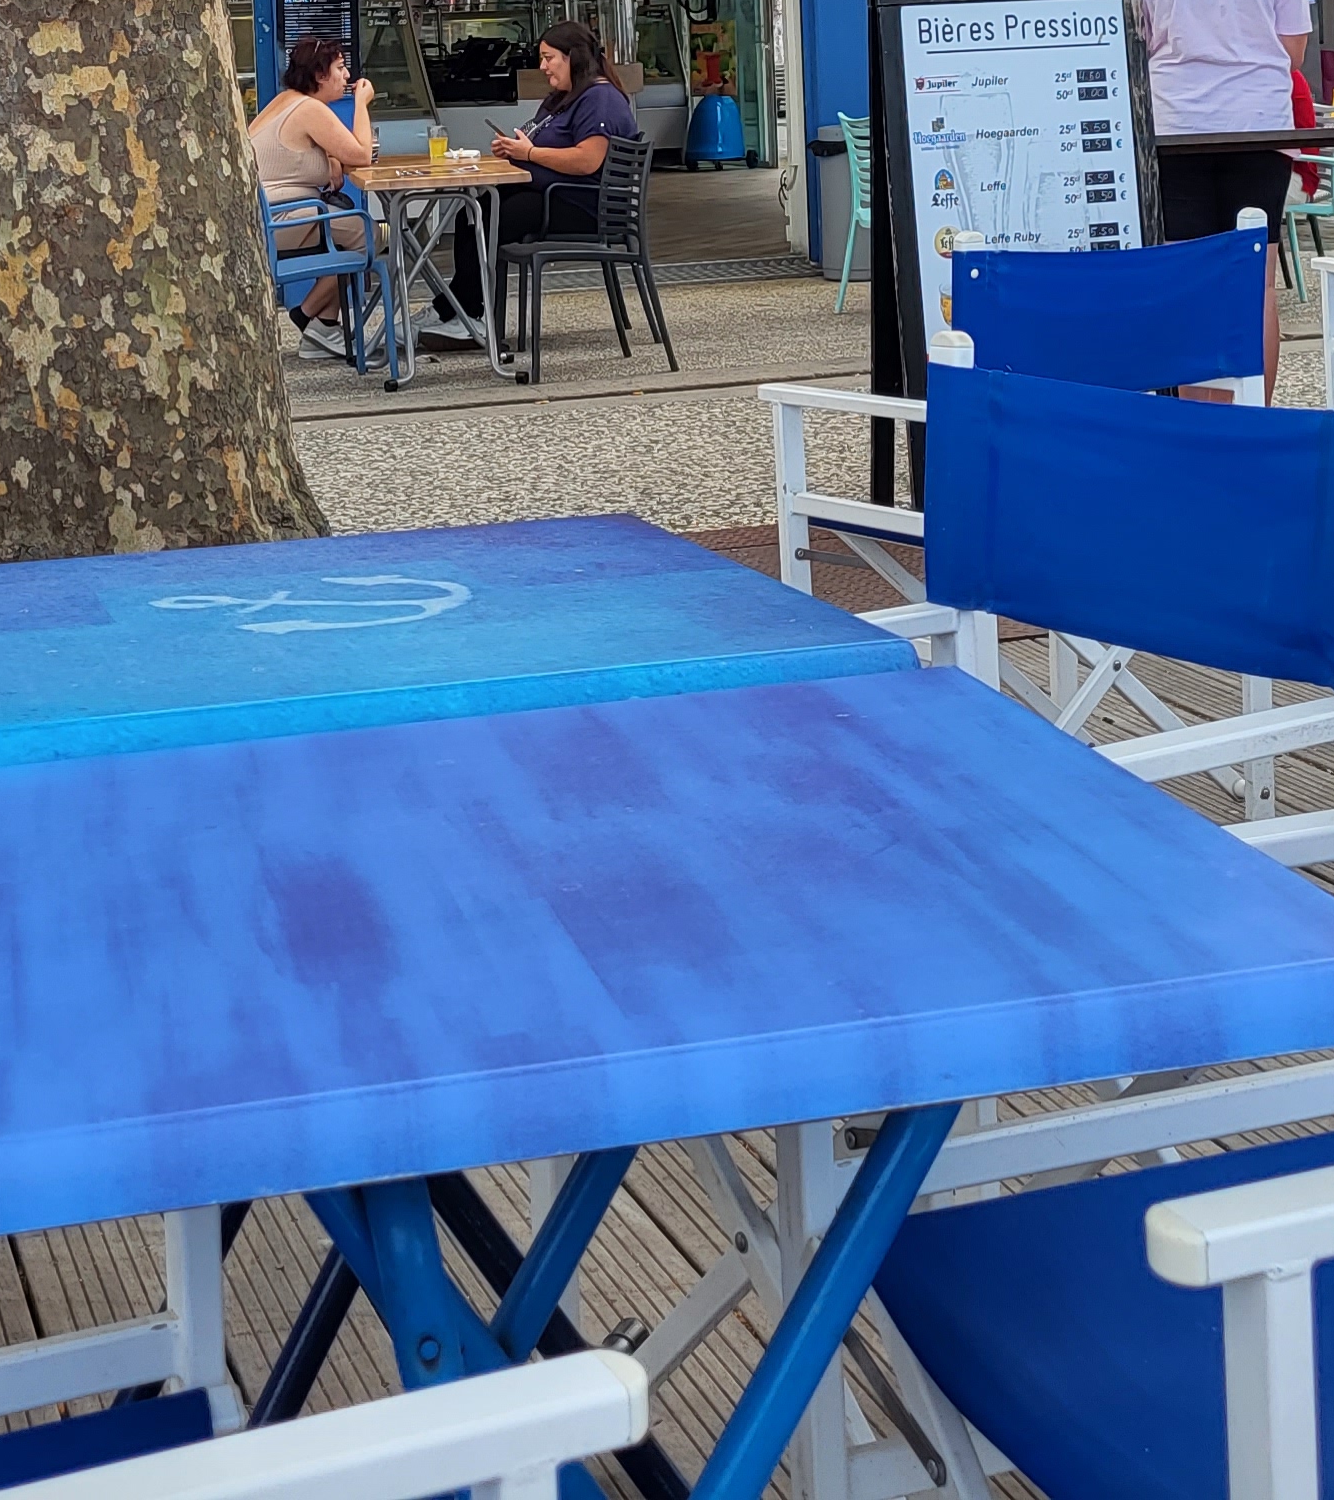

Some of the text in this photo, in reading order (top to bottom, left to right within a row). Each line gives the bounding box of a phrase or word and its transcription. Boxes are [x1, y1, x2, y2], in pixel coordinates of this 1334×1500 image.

[918, 11, 1119, 44] Bières Pressions
[1110, 69, 1118, 80] €
[927, 79, 959, 90] Jupiler
[971, 76, 1009, 89] Jupiler
[1112, 87, 1119, 97] €
[1114, 121, 1122, 131] €
[913, 129, 967, 145] Hoegaarden
[975, 127, 1040, 141] Hoegaarden
[1116, 138, 1123, 148] €
[1119, 172, 1126, 183] €
[980, 180, 1007, 192] Leffe
[930, 192, 959, 209] Leffe
[1120, 190, 1127, 200] €
[1123, 224, 1130, 235] €
[984, 231, 1042, 245] Leffe Ruby
